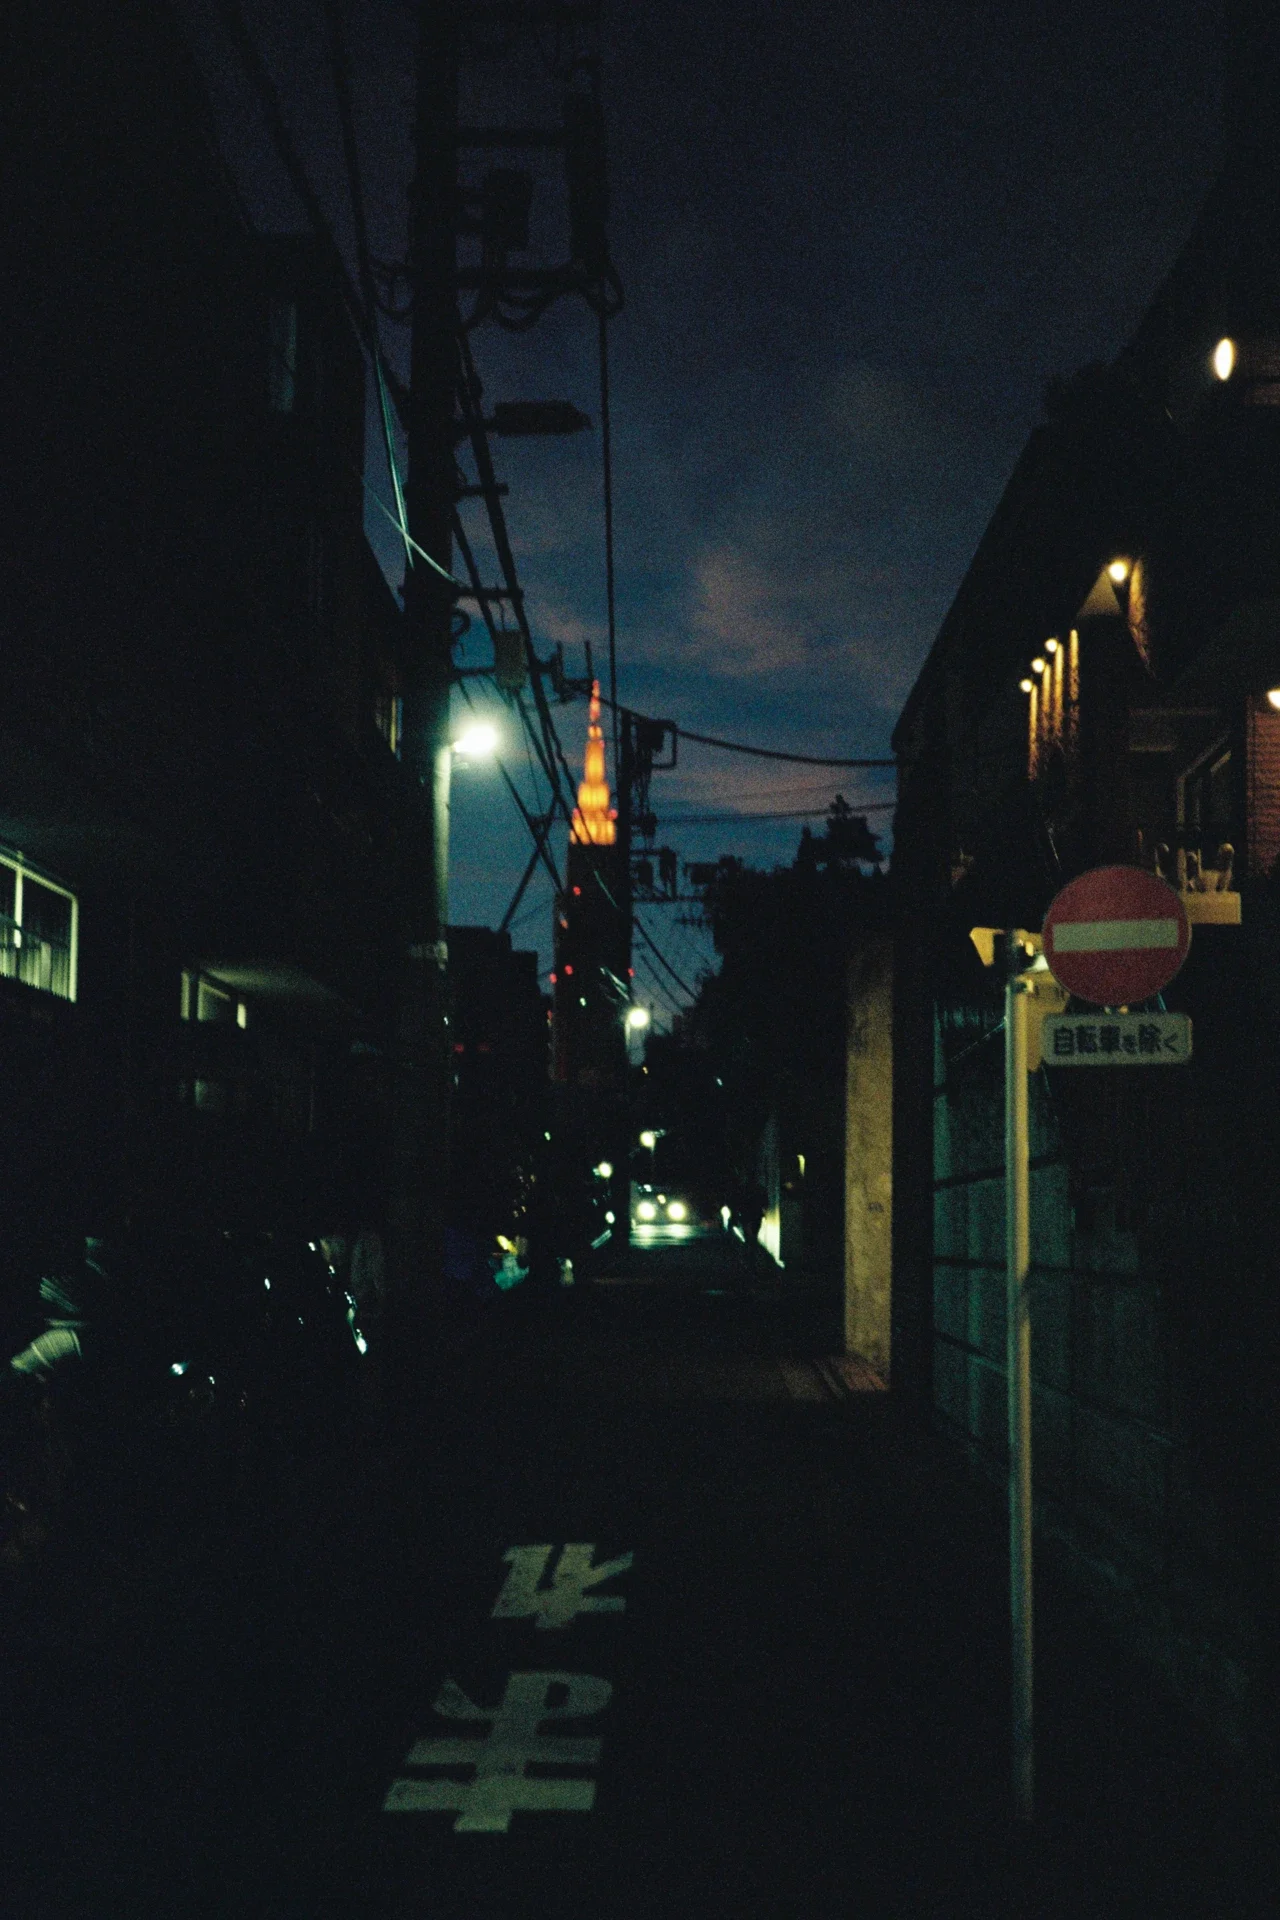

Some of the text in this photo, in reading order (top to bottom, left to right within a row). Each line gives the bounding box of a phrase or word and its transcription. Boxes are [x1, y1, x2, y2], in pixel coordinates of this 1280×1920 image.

[1053, 1022, 1178, 1055] 自転車を除く
